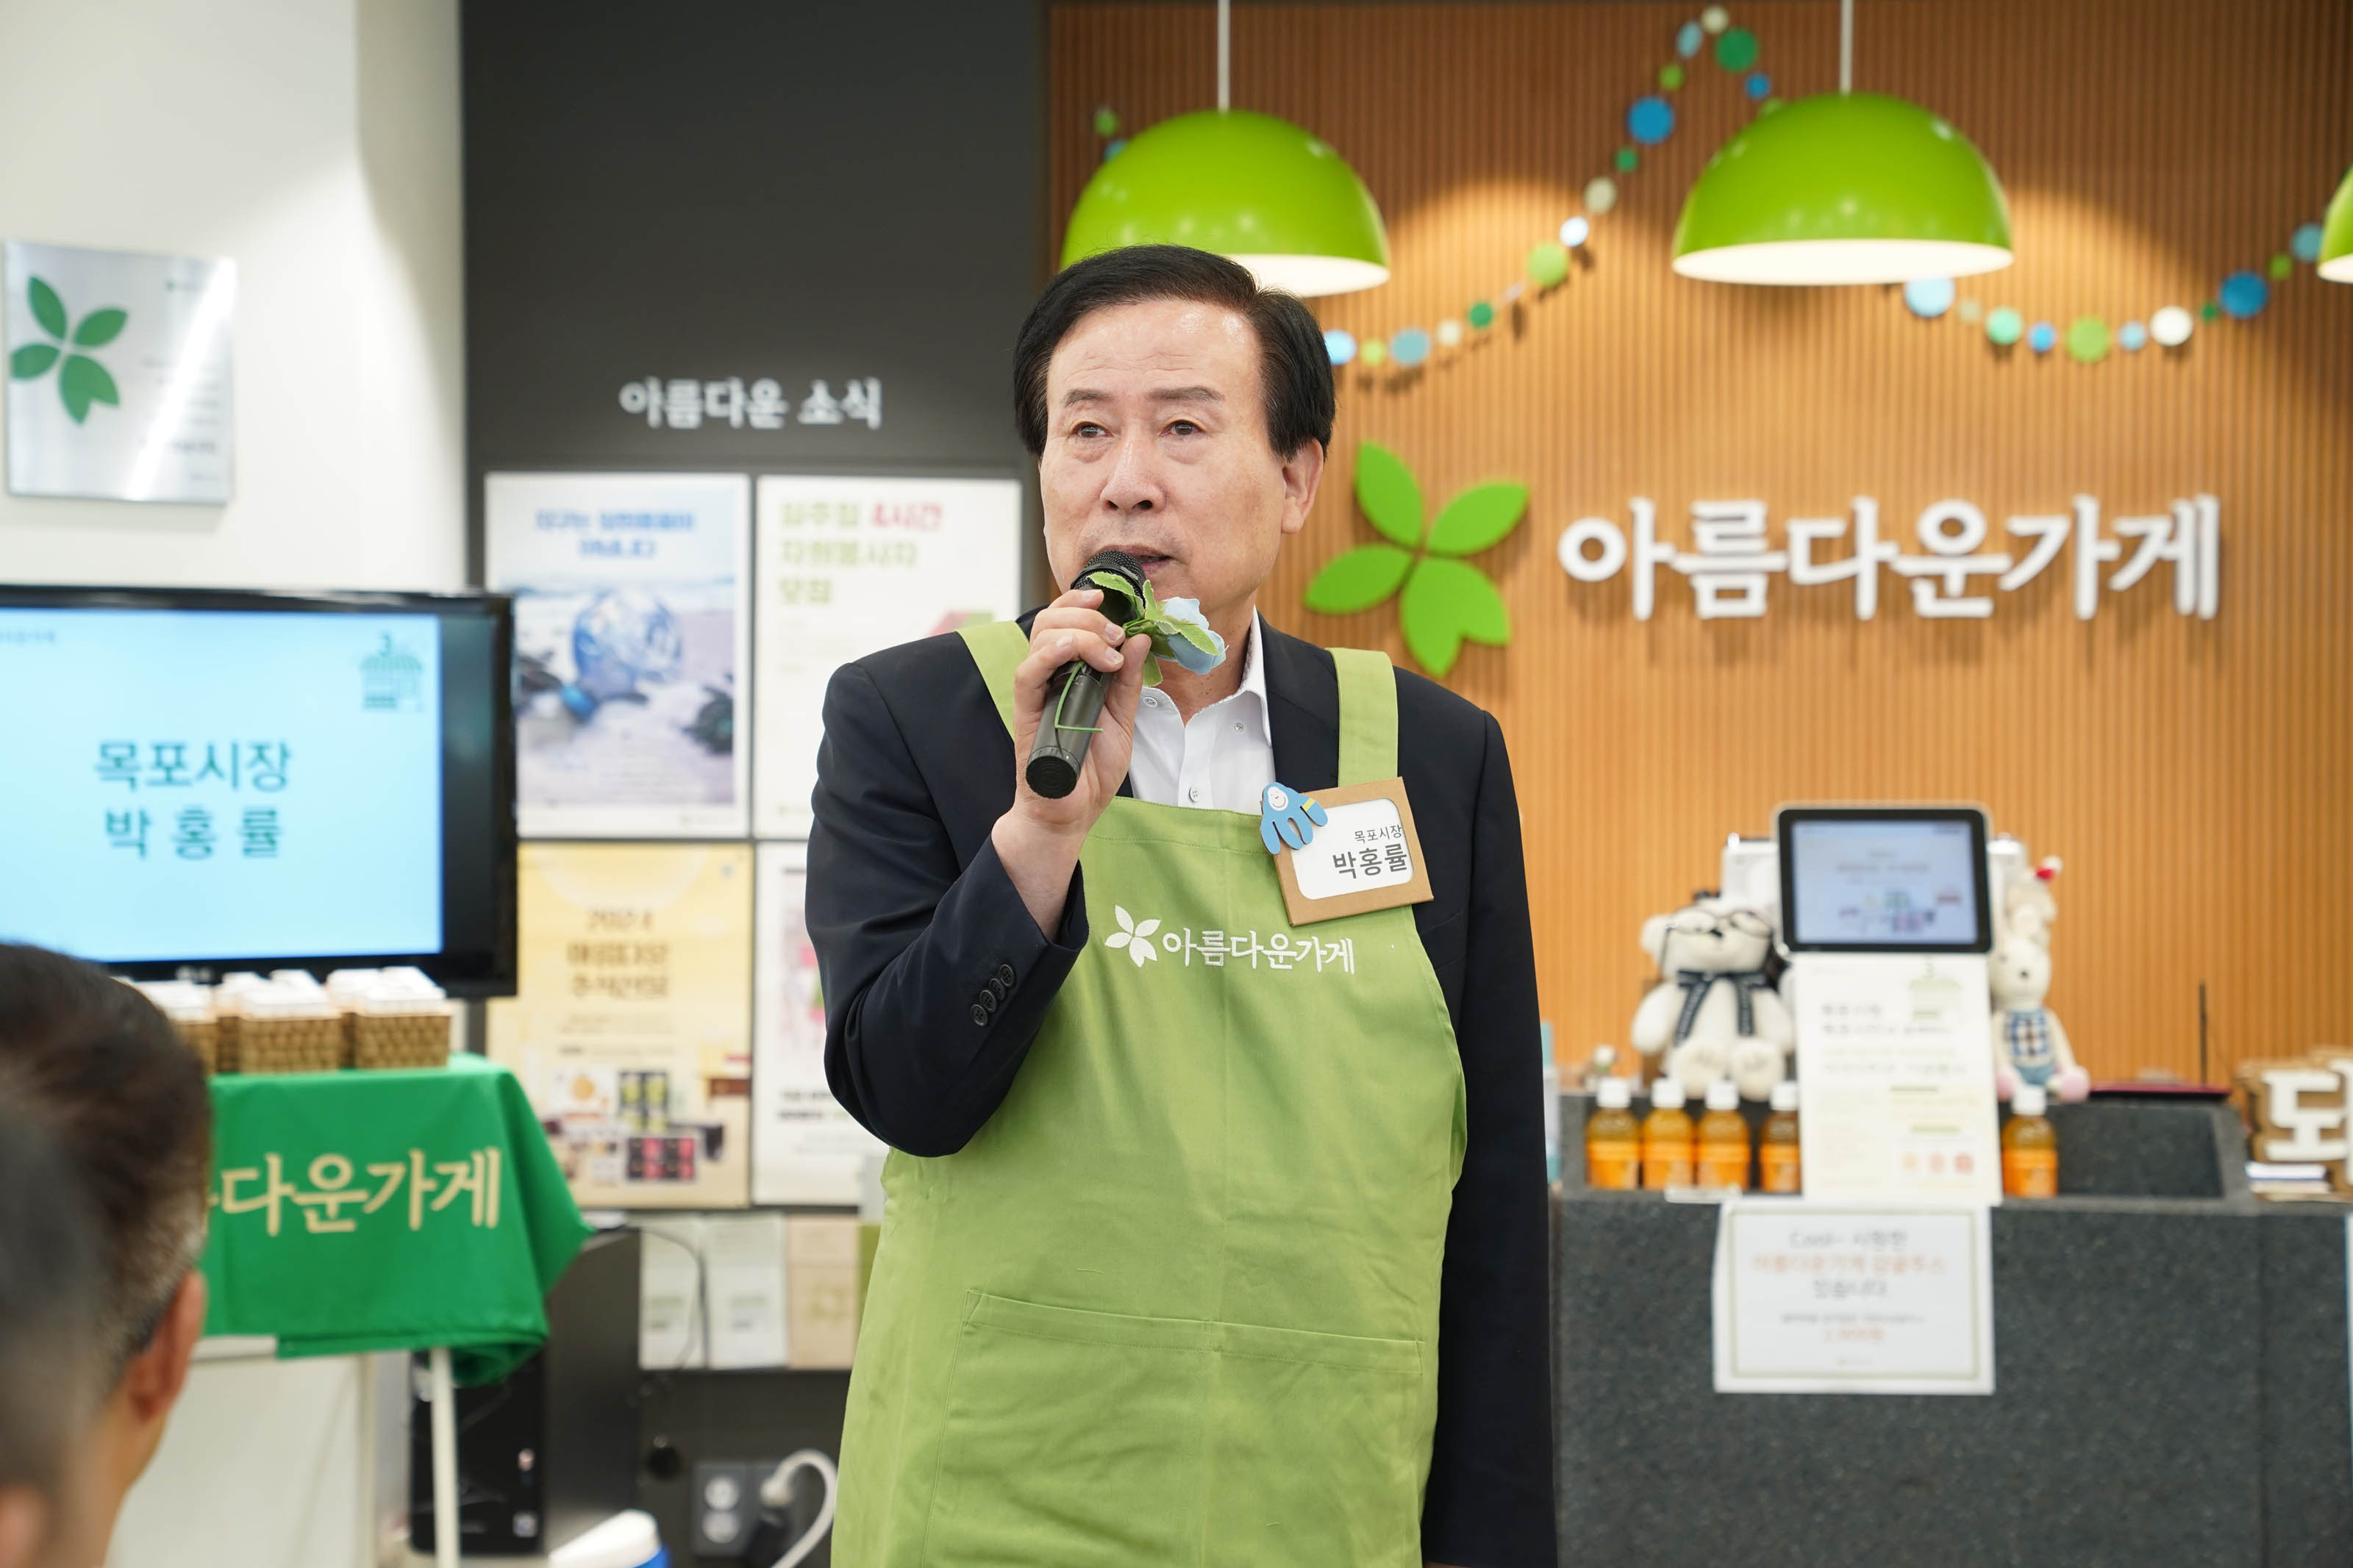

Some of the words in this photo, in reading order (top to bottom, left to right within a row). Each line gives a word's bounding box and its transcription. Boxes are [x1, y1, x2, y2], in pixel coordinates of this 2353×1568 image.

[619, 376, 789, 429] 아름다운
[798, 377, 882, 430] 소식
[1557, 495, 2220, 621] 아름다운가게
[95, 740, 291, 793] 목포시장
[1354, 824, 1402, 844] 목포시장
[1332, 844, 1407, 879] 박홍률
[1163, 927, 1354, 974] 아름다운가게
[207, 1147, 501, 1237] 다운가게
